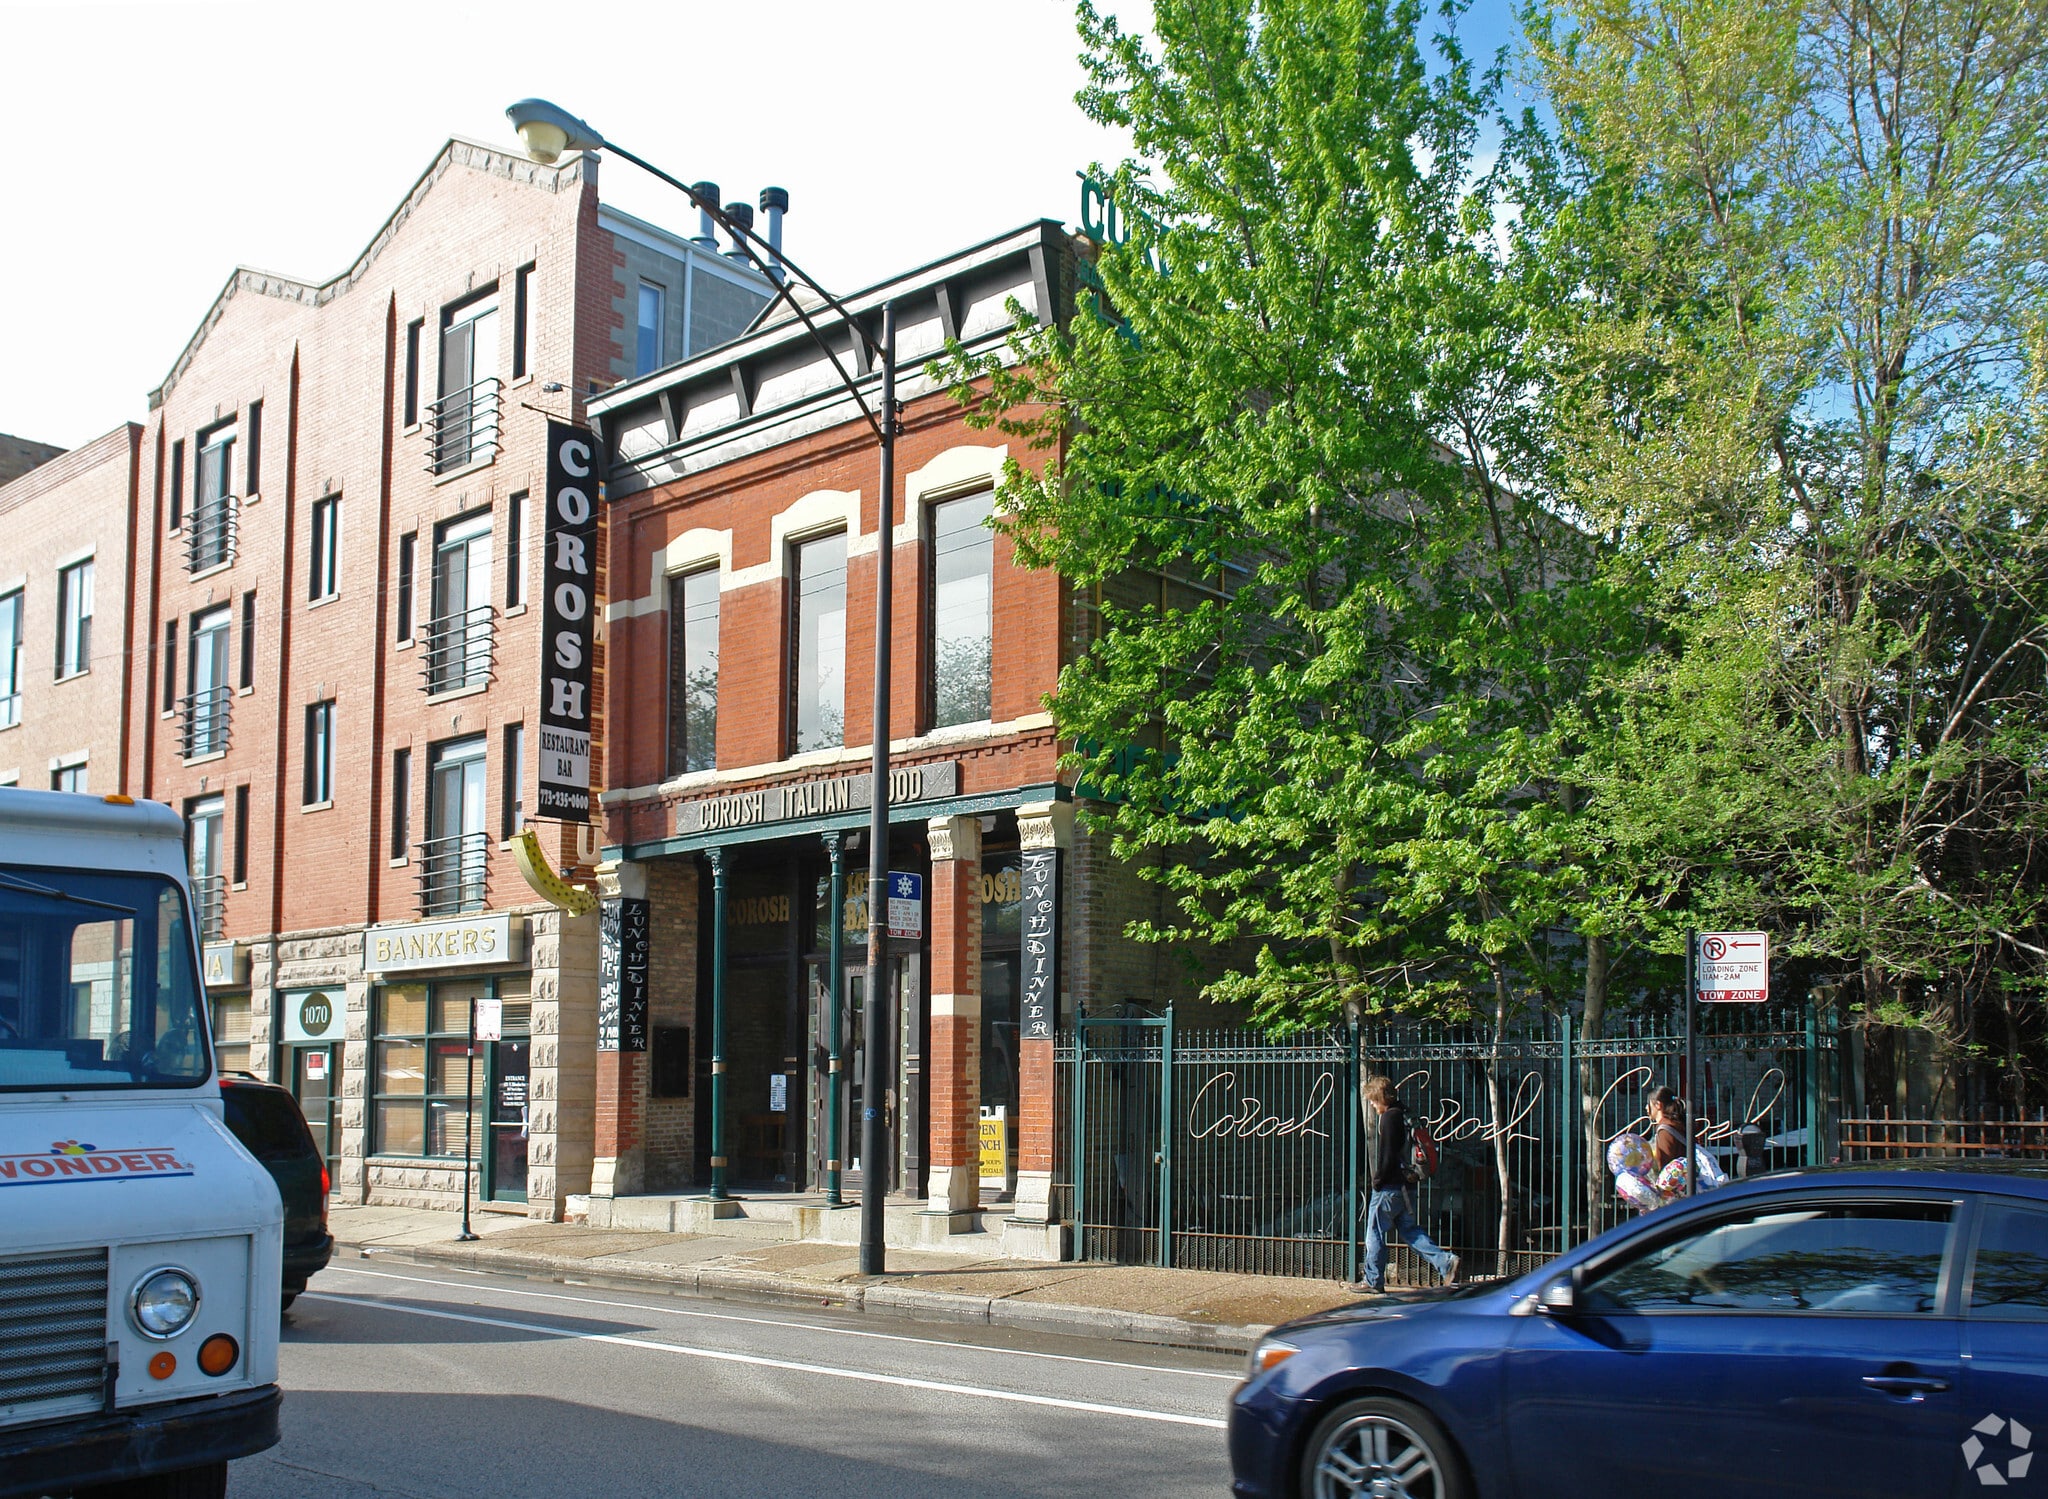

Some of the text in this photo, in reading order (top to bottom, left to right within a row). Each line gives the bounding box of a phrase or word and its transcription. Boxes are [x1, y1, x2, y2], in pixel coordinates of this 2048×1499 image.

[550, 439, 590, 719] COROSH
[542, 732, 590, 757] RESTAURANT
[557, 758, 572, 777] BAR
[700, 769, 922, 829] COROSH ITALIAN OOD
[982, 871, 1022, 904] OSH
[845, 901, 869, 930] BA
[376, 927, 496, 962] BANKERS
[1702, 965, 1735, 973] LOADING
[1702, 973, 1740, 981] 11AM-2AM
[1702, 990, 1760, 1000] TOW ZONE
[304, 1004, 328, 1025] 1070
[1189, 1071, 1335, 1138] Corosh
[980, 1124, 996, 1135] EN
[980, 1140, 1001, 1151] NCH
